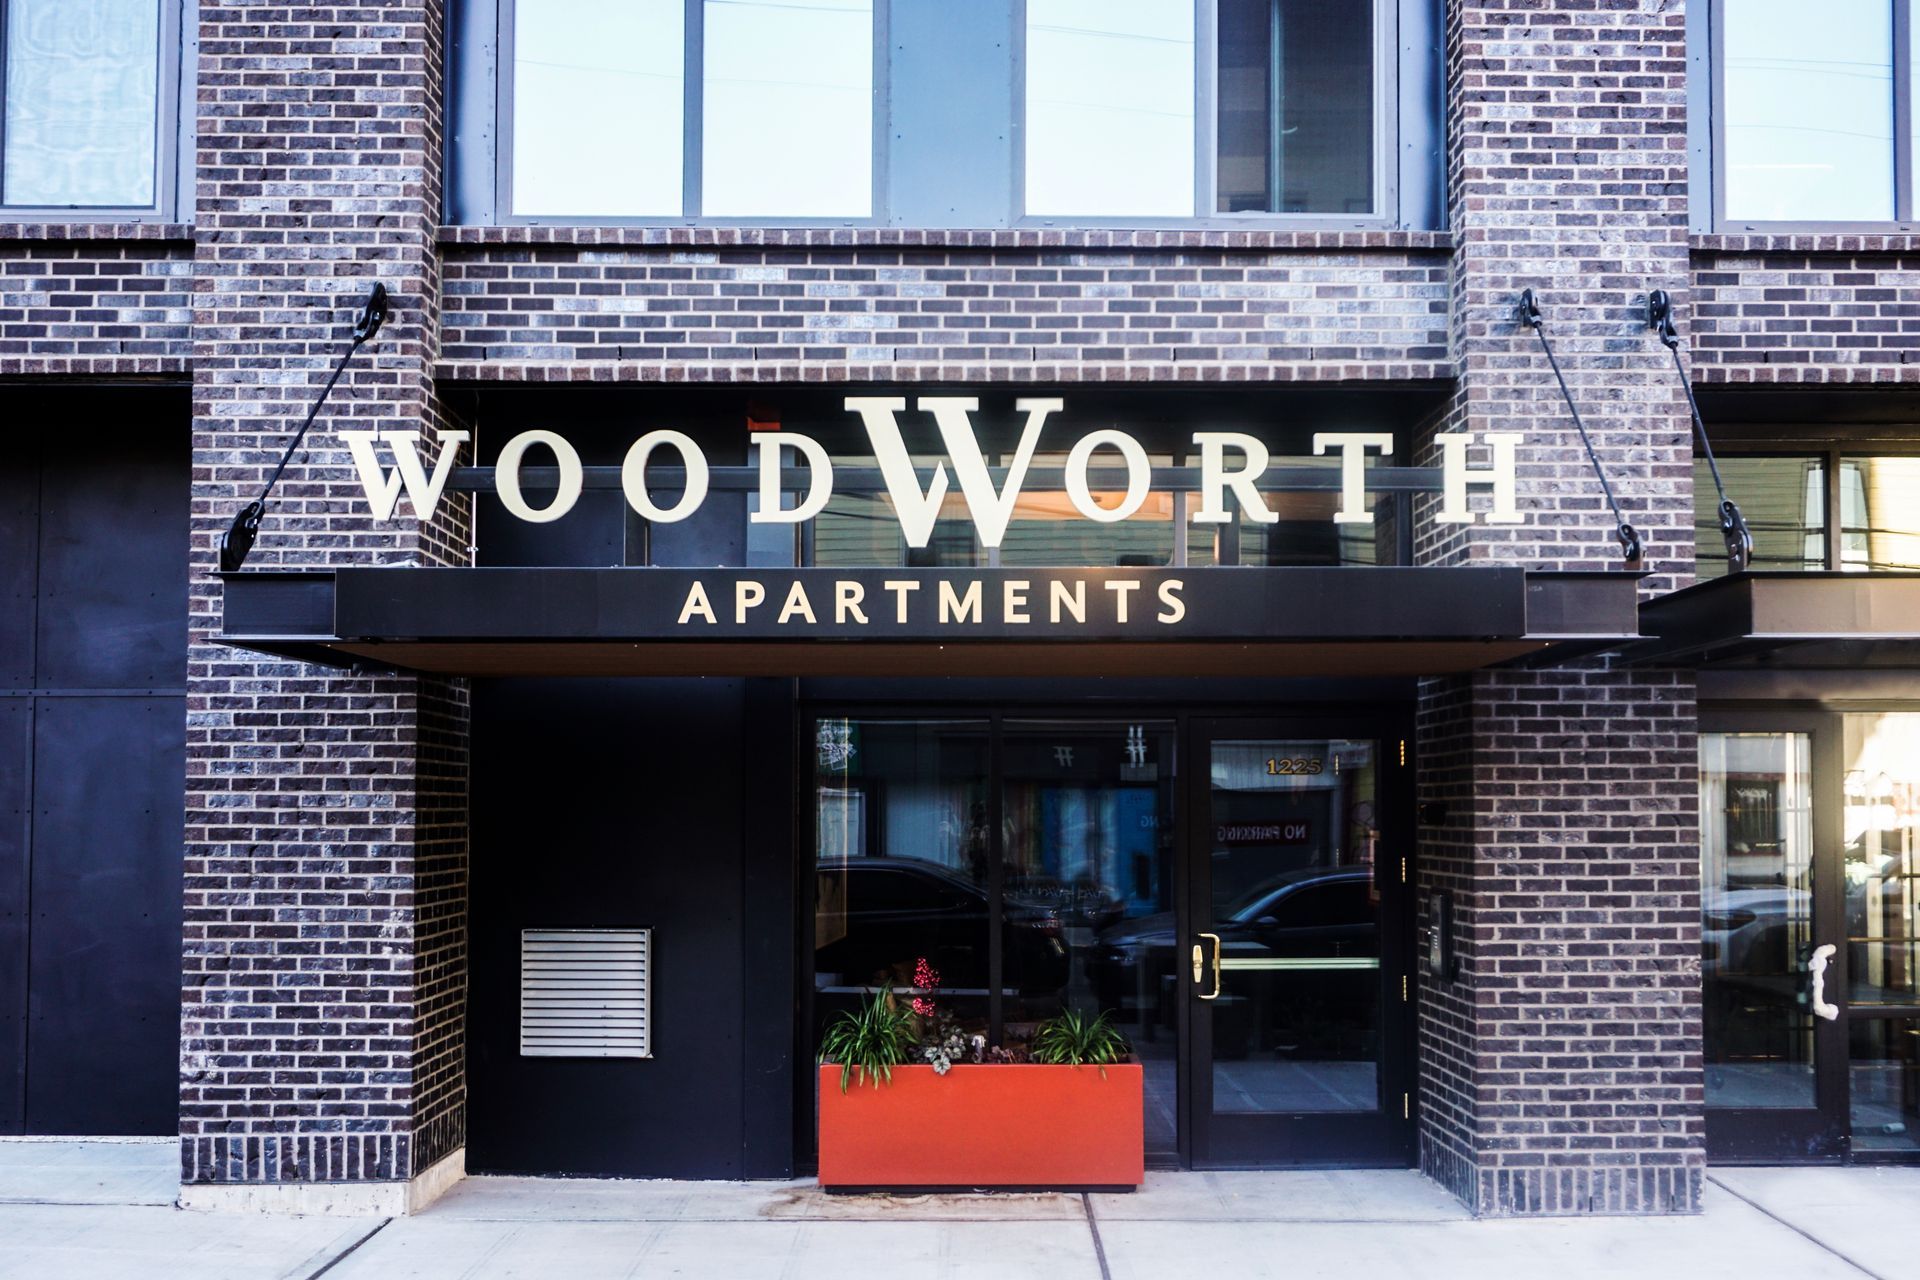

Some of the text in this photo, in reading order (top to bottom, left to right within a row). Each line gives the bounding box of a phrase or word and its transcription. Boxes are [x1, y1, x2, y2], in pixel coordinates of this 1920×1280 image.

[339, 397, 1526, 548] WOODWORTH
[677, 580, 1187, 624] APARTMENTS
[1266, 758, 1323, 775] 1225
